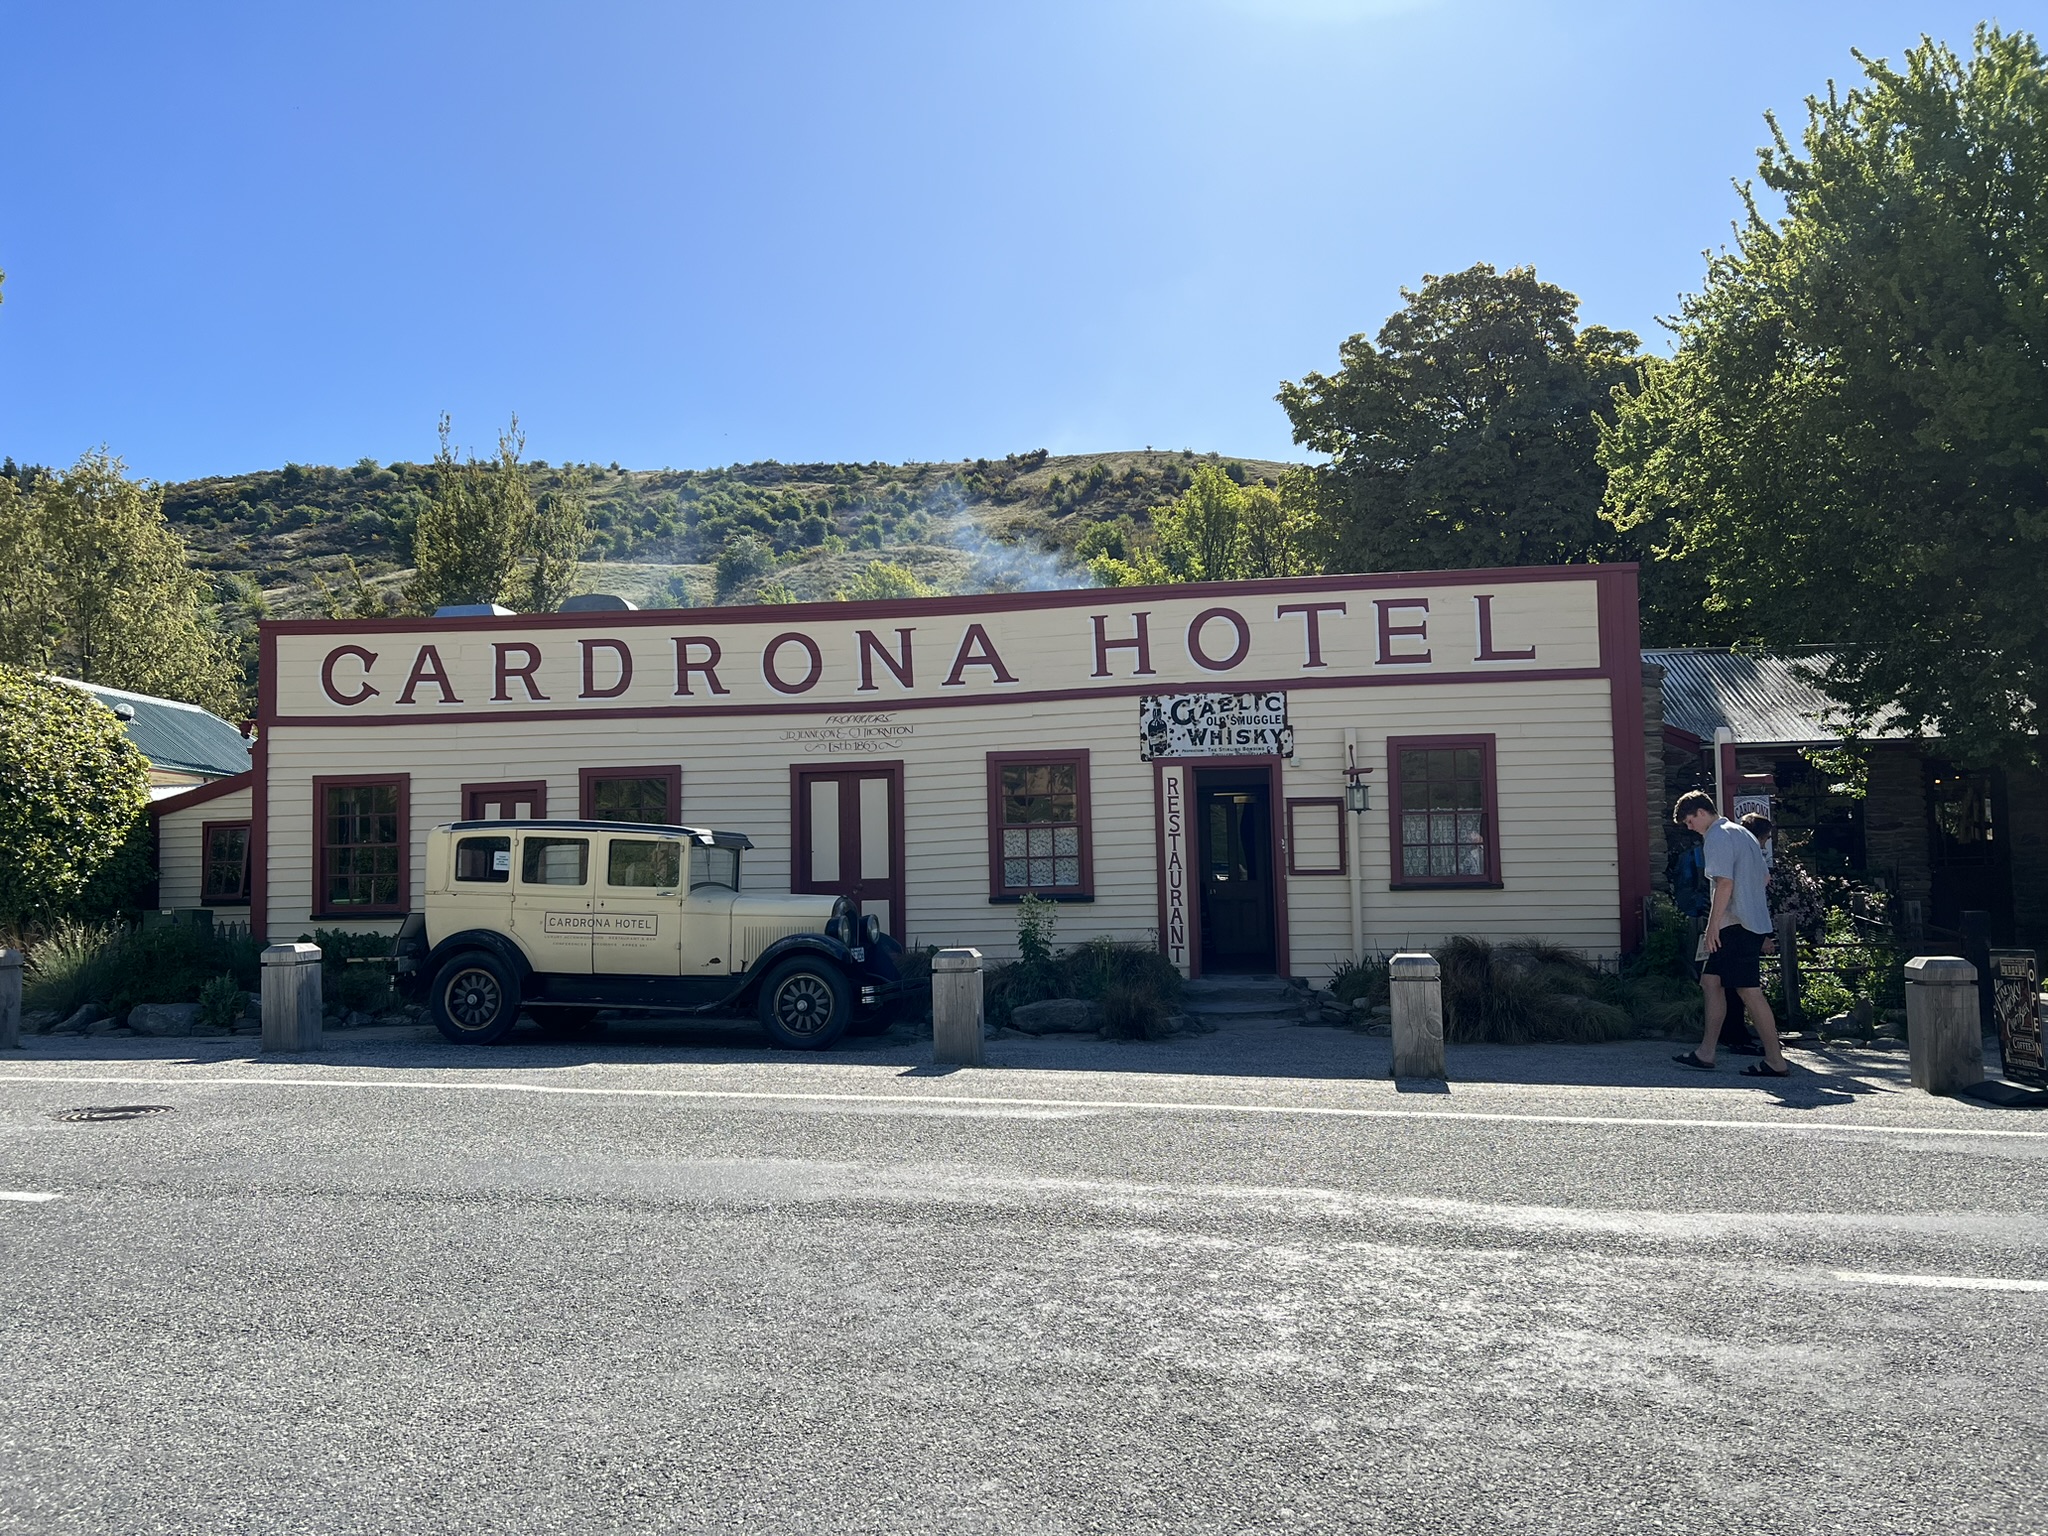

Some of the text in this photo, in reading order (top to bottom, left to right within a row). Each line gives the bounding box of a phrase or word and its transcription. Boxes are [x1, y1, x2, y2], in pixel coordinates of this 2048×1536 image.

[320, 595, 1536, 706] CARDRONA HOTEL
[1171, 695, 1282, 726] GAELIC
[1230, 715, 1286, 726] SMUGGLE
[854, 741, 877, 752] 1863
[1186, 729, 1284, 746] WHISKY
[1167, 777, 1184, 963] RESTAURANT
[549, 917, 652, 929] CARDRONA HOTEL
[2028, 968, 2043, 1058] OPEN
